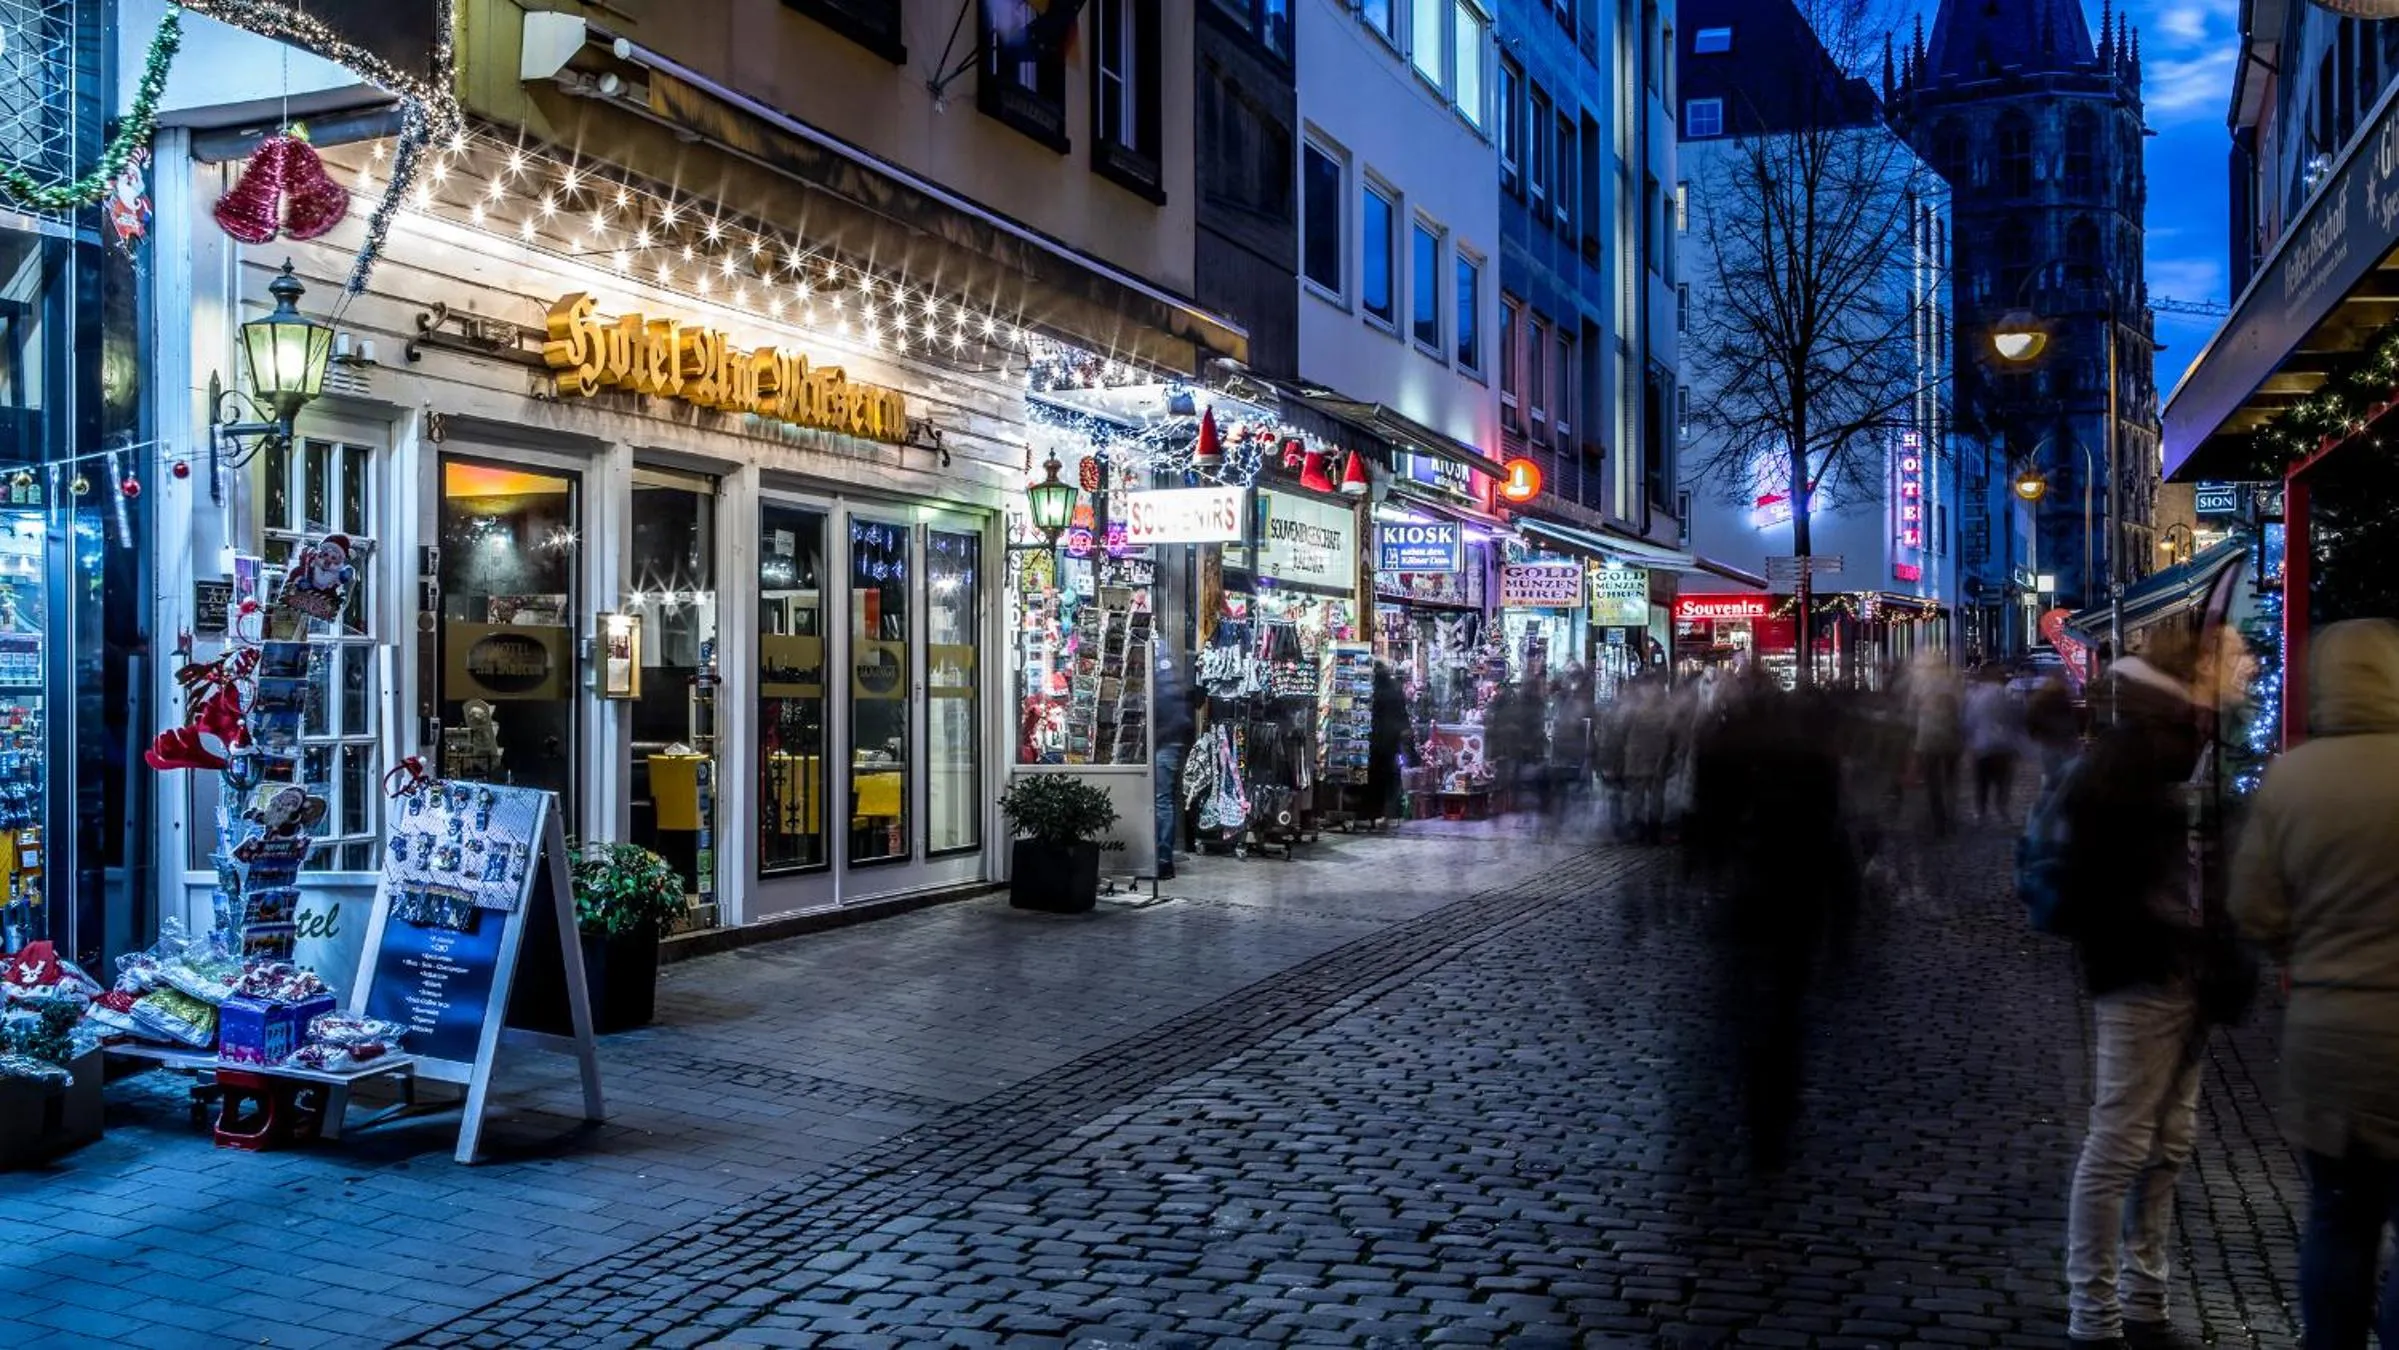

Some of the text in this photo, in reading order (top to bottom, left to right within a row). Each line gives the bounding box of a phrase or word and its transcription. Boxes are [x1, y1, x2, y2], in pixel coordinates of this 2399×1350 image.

[546, 291, 686, 398] Hotel
[1903, 432, 1921, 546] HOTEL
[2199, 496, 2234, 508] SION
[1132, 496, 1235, 535] SOUENIRS
[1383, 527, 1453, 544] KIOSK
[1505, 567, 1579, 578] GOLD
[1597, 572, 1645, 580] GOLD
[1505, 577, 1578, 588] MÜNZEN
[1505, 589, 1578, 599] UHREN
[1682, 600, 1764, 616] Souvenirs
[297, 902, 340, 939] tel
